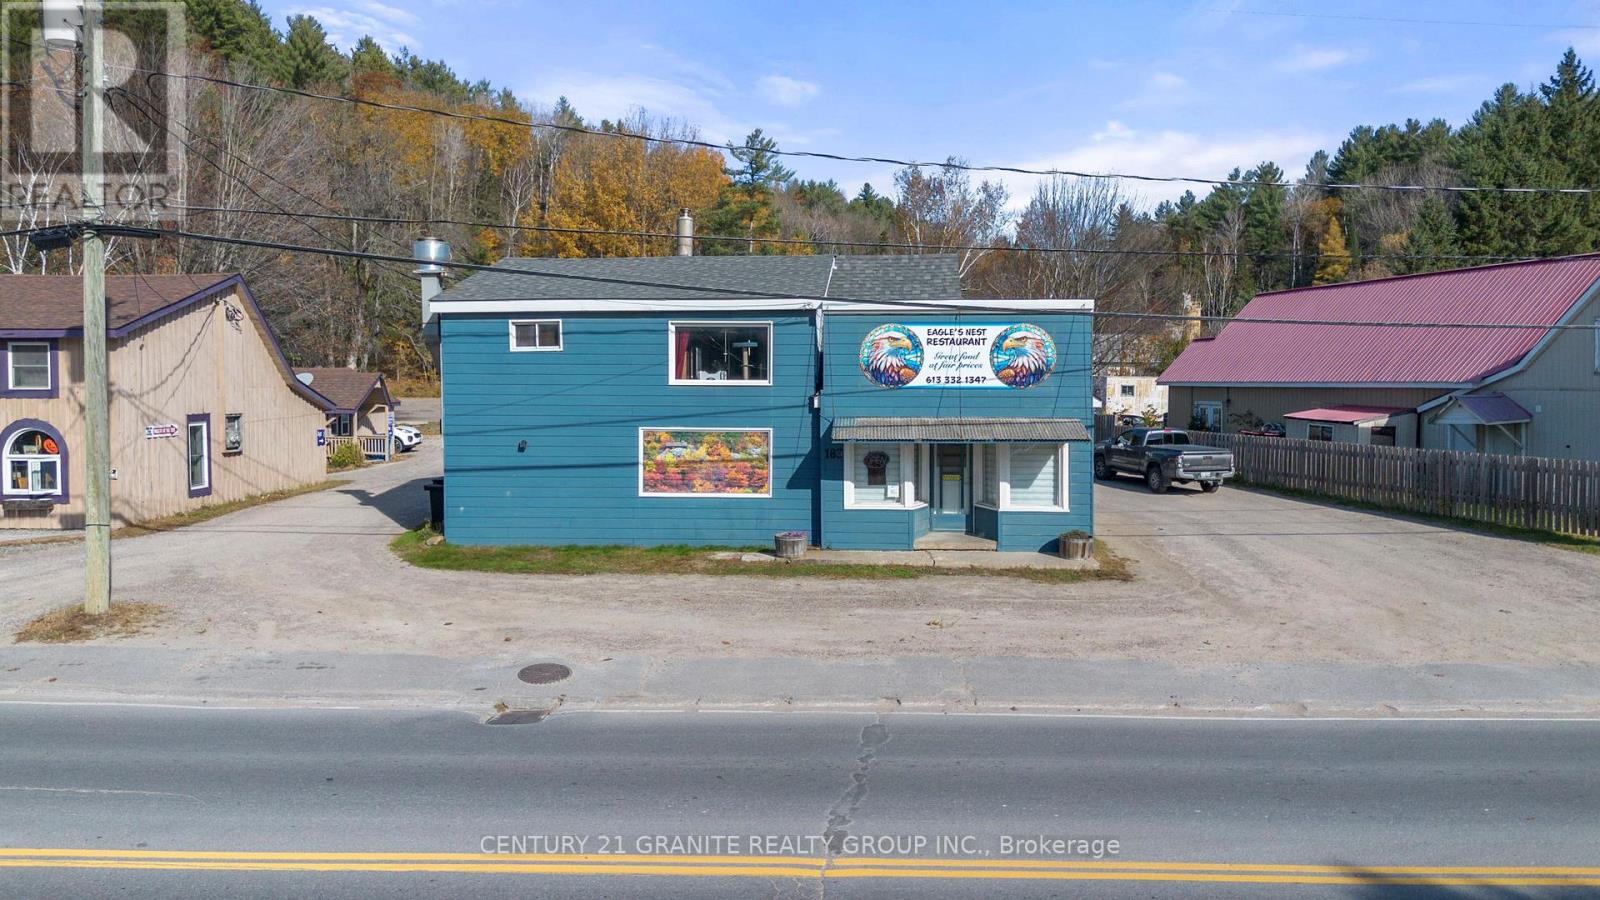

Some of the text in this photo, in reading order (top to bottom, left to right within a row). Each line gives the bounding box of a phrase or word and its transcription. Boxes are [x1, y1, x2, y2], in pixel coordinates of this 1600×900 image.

[927, 328, 987, 336] EAGLE'S NEST
[926, 337, 987, 346] RESTAURANT
[934, 351, 980, 362] Great food
[929, 361, 983, 371] at fair prices
[926, 376, 987, 384] 613 332 1347
